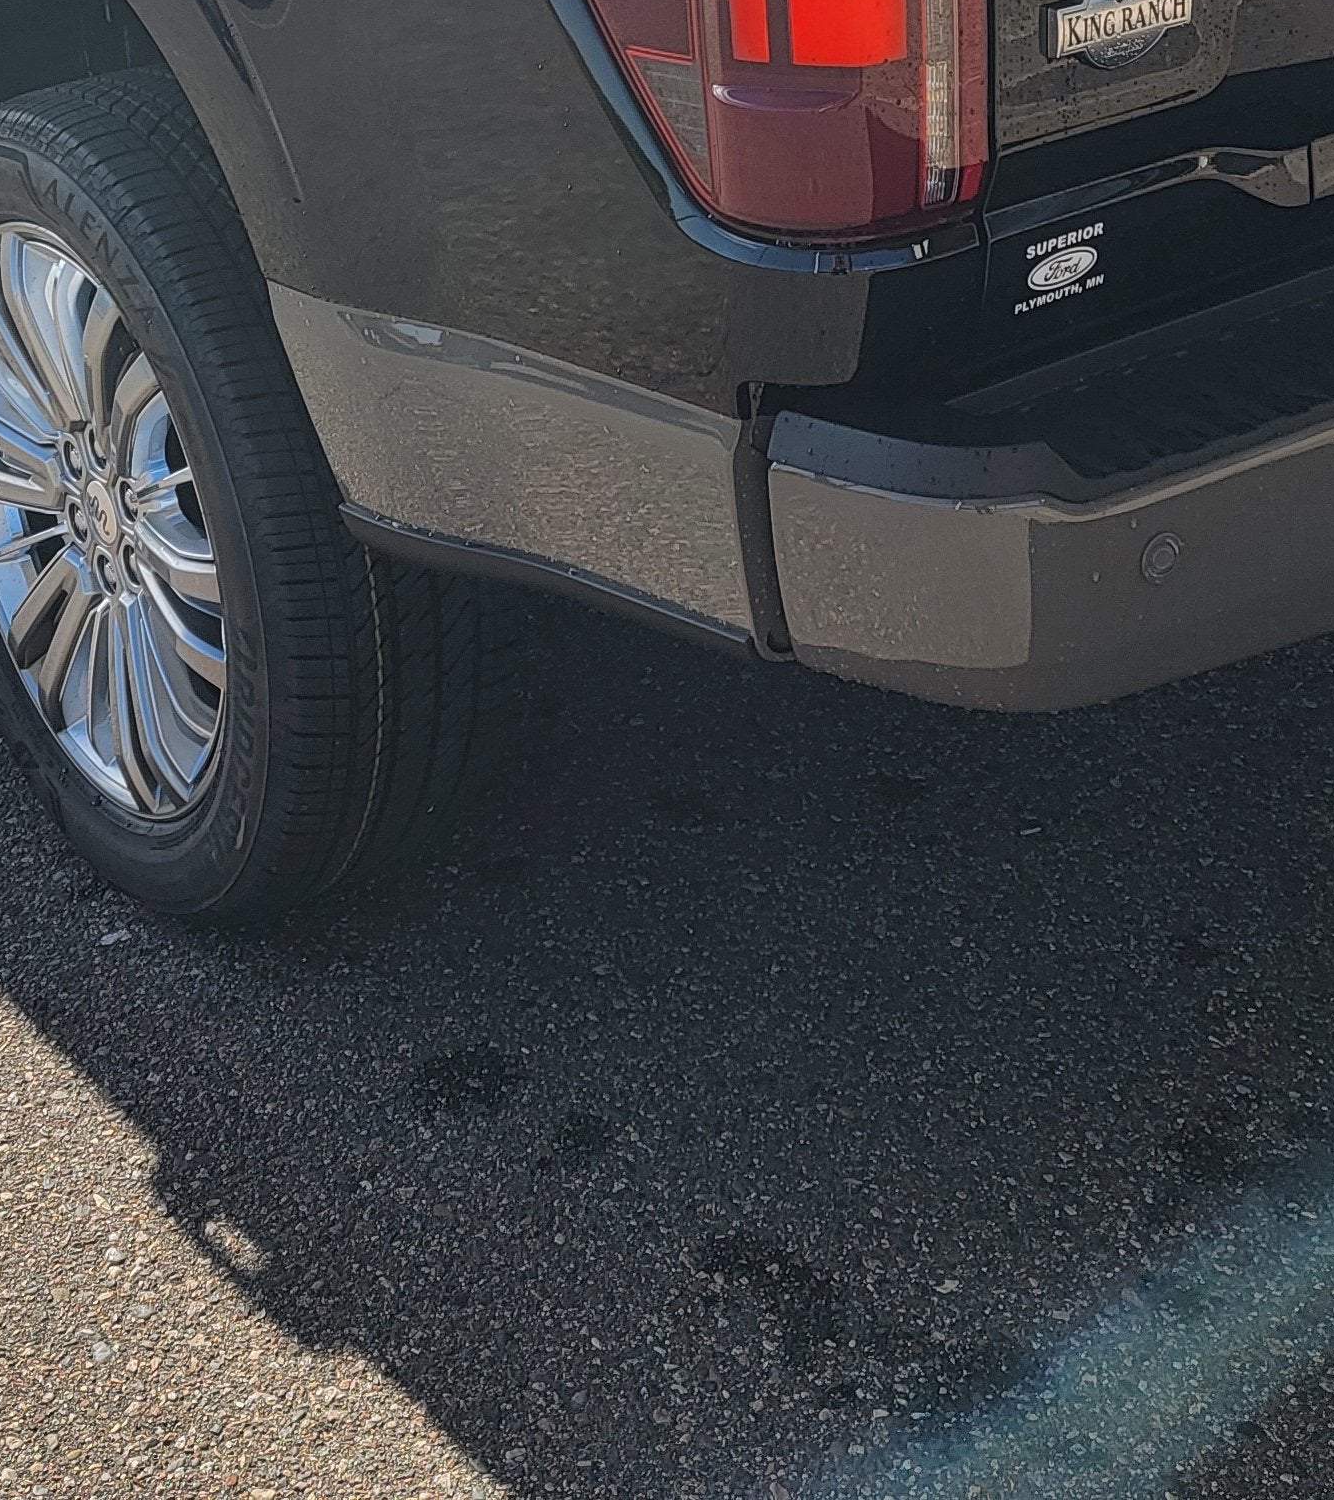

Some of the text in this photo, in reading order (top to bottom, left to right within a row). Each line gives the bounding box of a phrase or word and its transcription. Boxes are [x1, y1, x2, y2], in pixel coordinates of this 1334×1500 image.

[1067, 11, 1117, 48] KING
[1025, 222, 1104, 260] SUPERIOR
[1043, 256, 1083, 283] Ford
[1014, 274, 1105, 315] PLYMOUTH, MN
